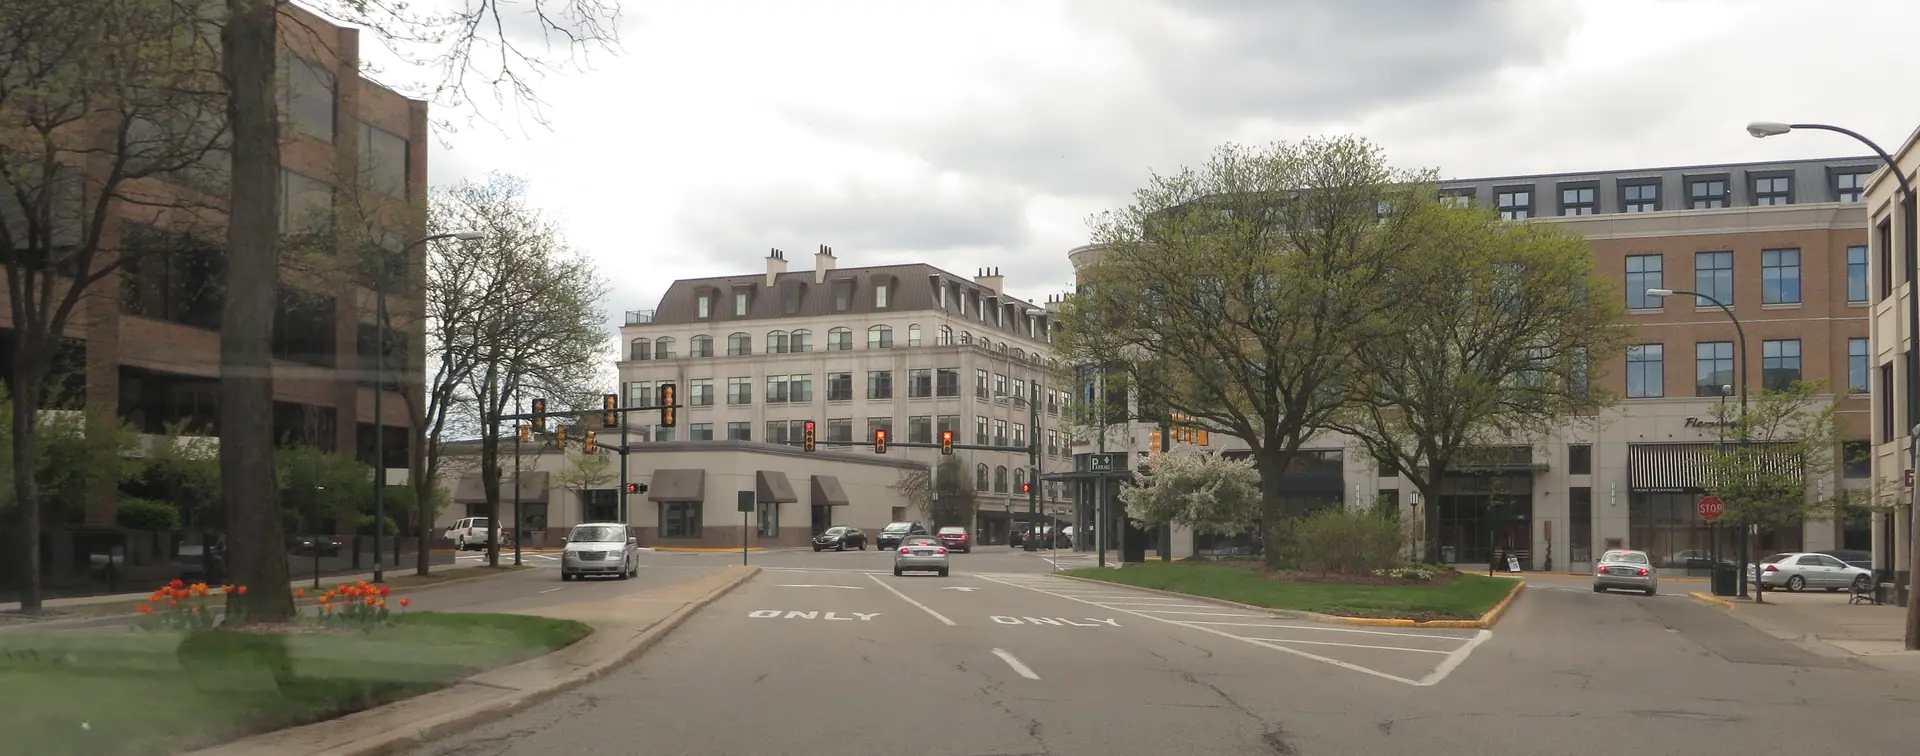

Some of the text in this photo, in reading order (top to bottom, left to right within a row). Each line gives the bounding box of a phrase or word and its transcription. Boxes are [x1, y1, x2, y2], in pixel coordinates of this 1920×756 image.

[1700, 503, 1723, 514] STOP
[748, 609, 882, 621] ONLY
[989, 614, 1123, 627] ONLY
